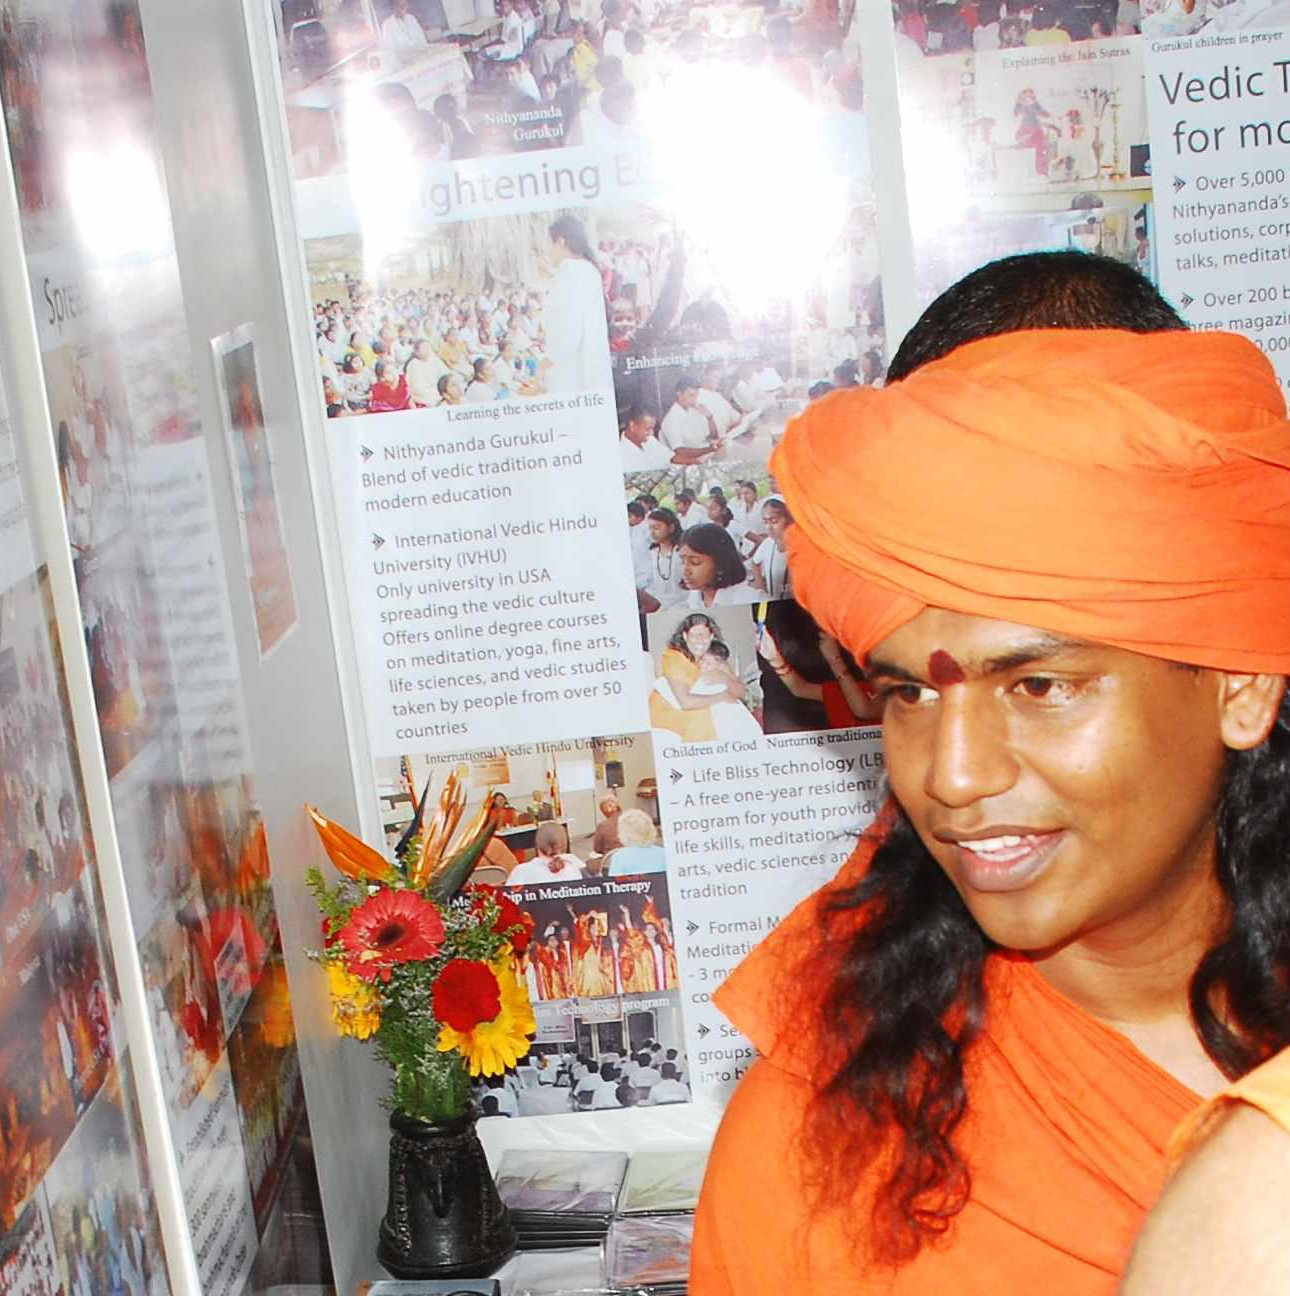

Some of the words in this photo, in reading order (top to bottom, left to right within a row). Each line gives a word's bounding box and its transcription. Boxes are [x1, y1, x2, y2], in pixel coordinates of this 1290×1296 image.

[1159, 66, 1263, 104] Vedic
[1173, 120, 1225, 154] for
[1196, 176, 1235, 191] Over
[1241, 169, 1285, 188] 5,000
[1175, 226, 1253, 245] solutions,
[1176, 254, 1217, 270] talks,
[384, 436, 485, 461] Nithyananda
[490, 428, 553, 448] Gurukul
[362, 468, 407, 488] Blend
[411, 466, 427, 482] of
[431, 464, 474, 480] vedic
[478, 456, 547, 475] tradition
[553, 450, 582, 467] and
[365, 494, 427, 511] modern
[432, 485, 512, 504] education
[395, 524, 497, 548] International
[501, 520, 544, 536] Vedic
[549, 514, 597, 532] Hindu
[373, 556, 452, 575] University
[457, 548, 507, 568] (IVHU)
[376, 582, 412, 600] Only
[418, 576, 494, 594] university
[499, 572, 514, 586] in
[519, 568, 551, 584] USA
[381, 604, 458, 626] spreading
[462, 600, 488, 614] the
[493, 594, 535, 610] vedic
[539, 590, 595, 606] culture
[663, 745, 713, 759] Children
[717, 742, 729, 753] of
[731, 740, 757, 752] God
[693, 768, 721, 782] Life
[725, 766, 759, 780] Bliss
[762, 758, 858, 778] Technology
